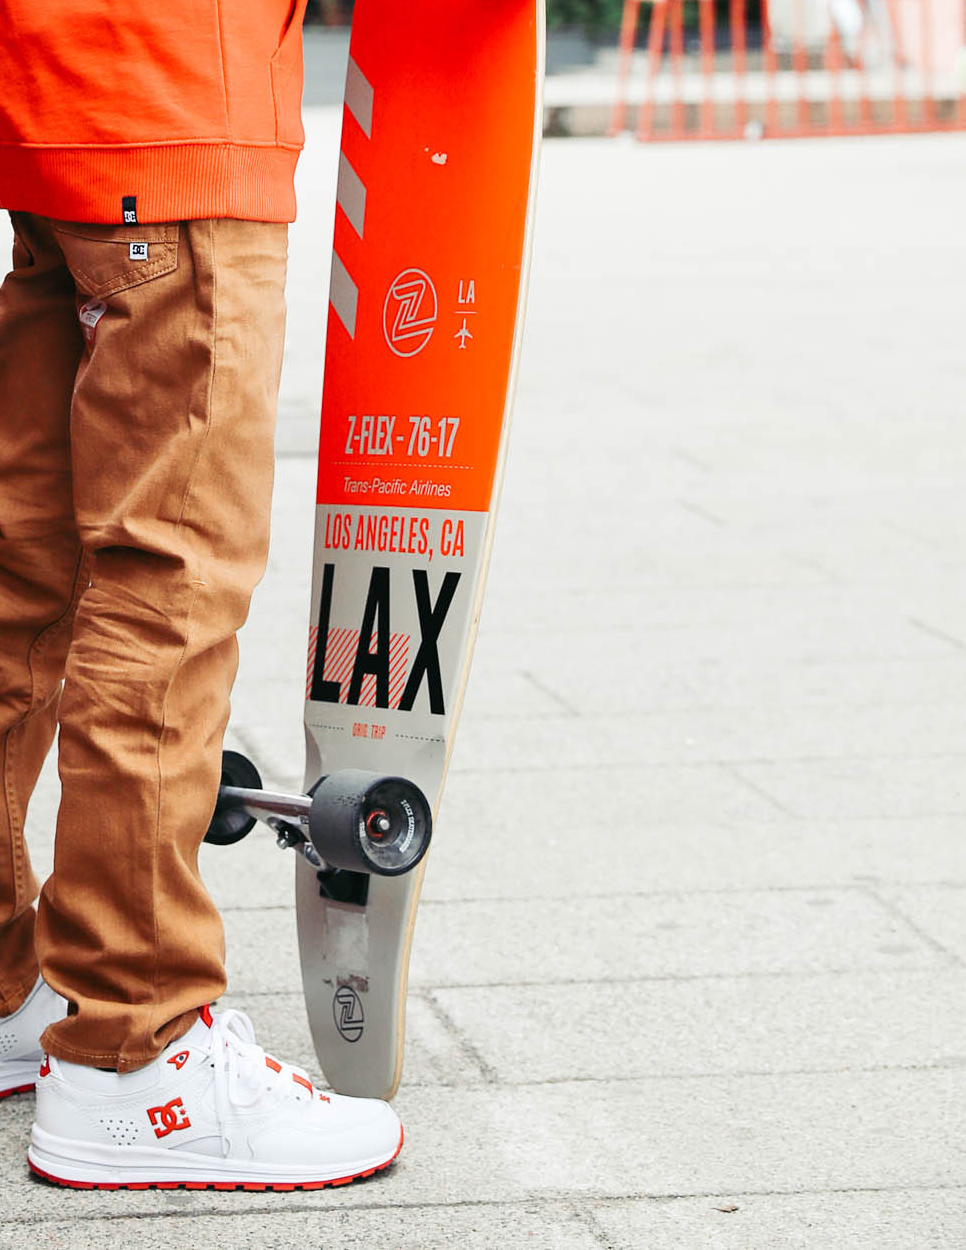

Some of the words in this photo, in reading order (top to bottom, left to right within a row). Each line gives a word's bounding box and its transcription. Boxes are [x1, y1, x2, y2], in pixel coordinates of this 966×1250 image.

[457, 279, 475, 304] LA
[345, 415, 396, 455] Z-FLEX
[407, 415, 460, 458] 76-17
[344, 476, 407, 495] Trans-Pacific
[408, 479, 452, 497] Airlines
[324, 513, 352, 550] LOS
[354, 514, 433, 562] ANGELES,
[440, 518, 464, 557] CA
[309, 563, 462, 716] LAX
[146, 1096, 191, 1139] DC
